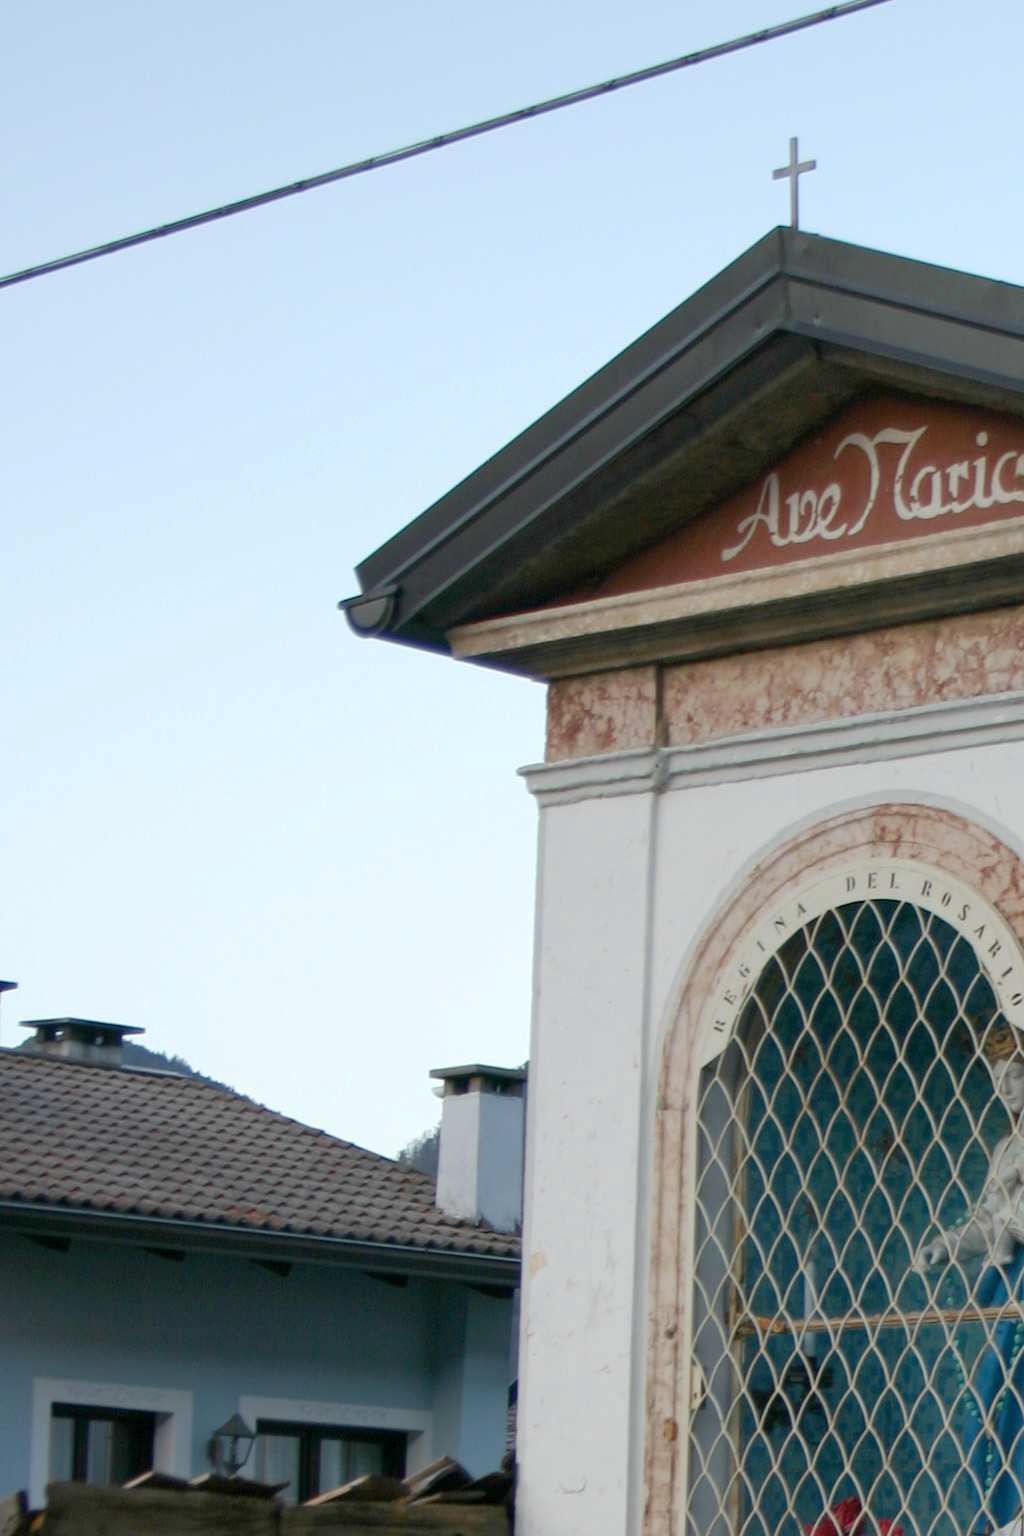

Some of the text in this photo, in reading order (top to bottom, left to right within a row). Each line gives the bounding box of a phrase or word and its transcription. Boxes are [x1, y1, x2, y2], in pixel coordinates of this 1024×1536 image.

[721, 472, 847, 562] Ave
[712, 872, 1023, 1033] REGINA DEL ROSARIO
